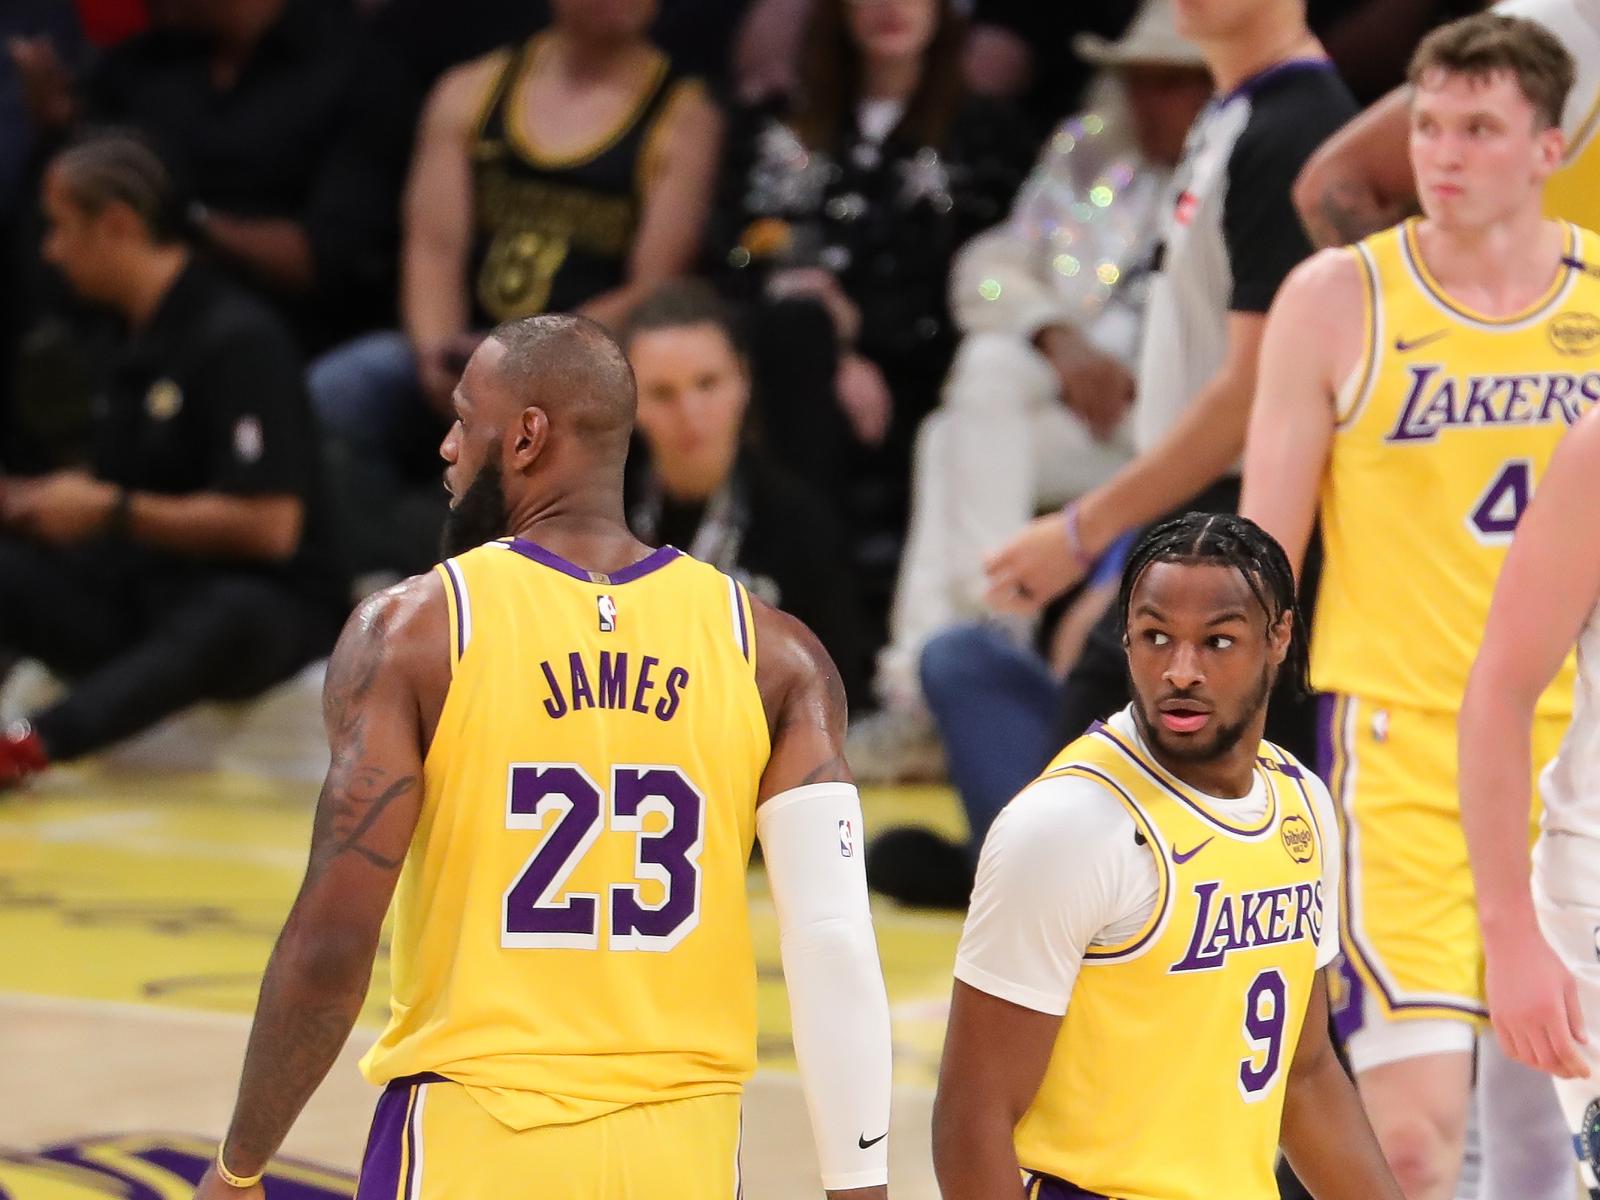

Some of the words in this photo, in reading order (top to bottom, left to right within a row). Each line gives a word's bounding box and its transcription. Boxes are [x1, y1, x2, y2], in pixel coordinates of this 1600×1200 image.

[1464, 460, 1535, 545] 4
[540, 650, 689, 721] JAMES
[501, 762, 706, 952] 23
[1168, 880, 1323, 973] LAKERS
[1238, 967, 1288, 1103] 9
